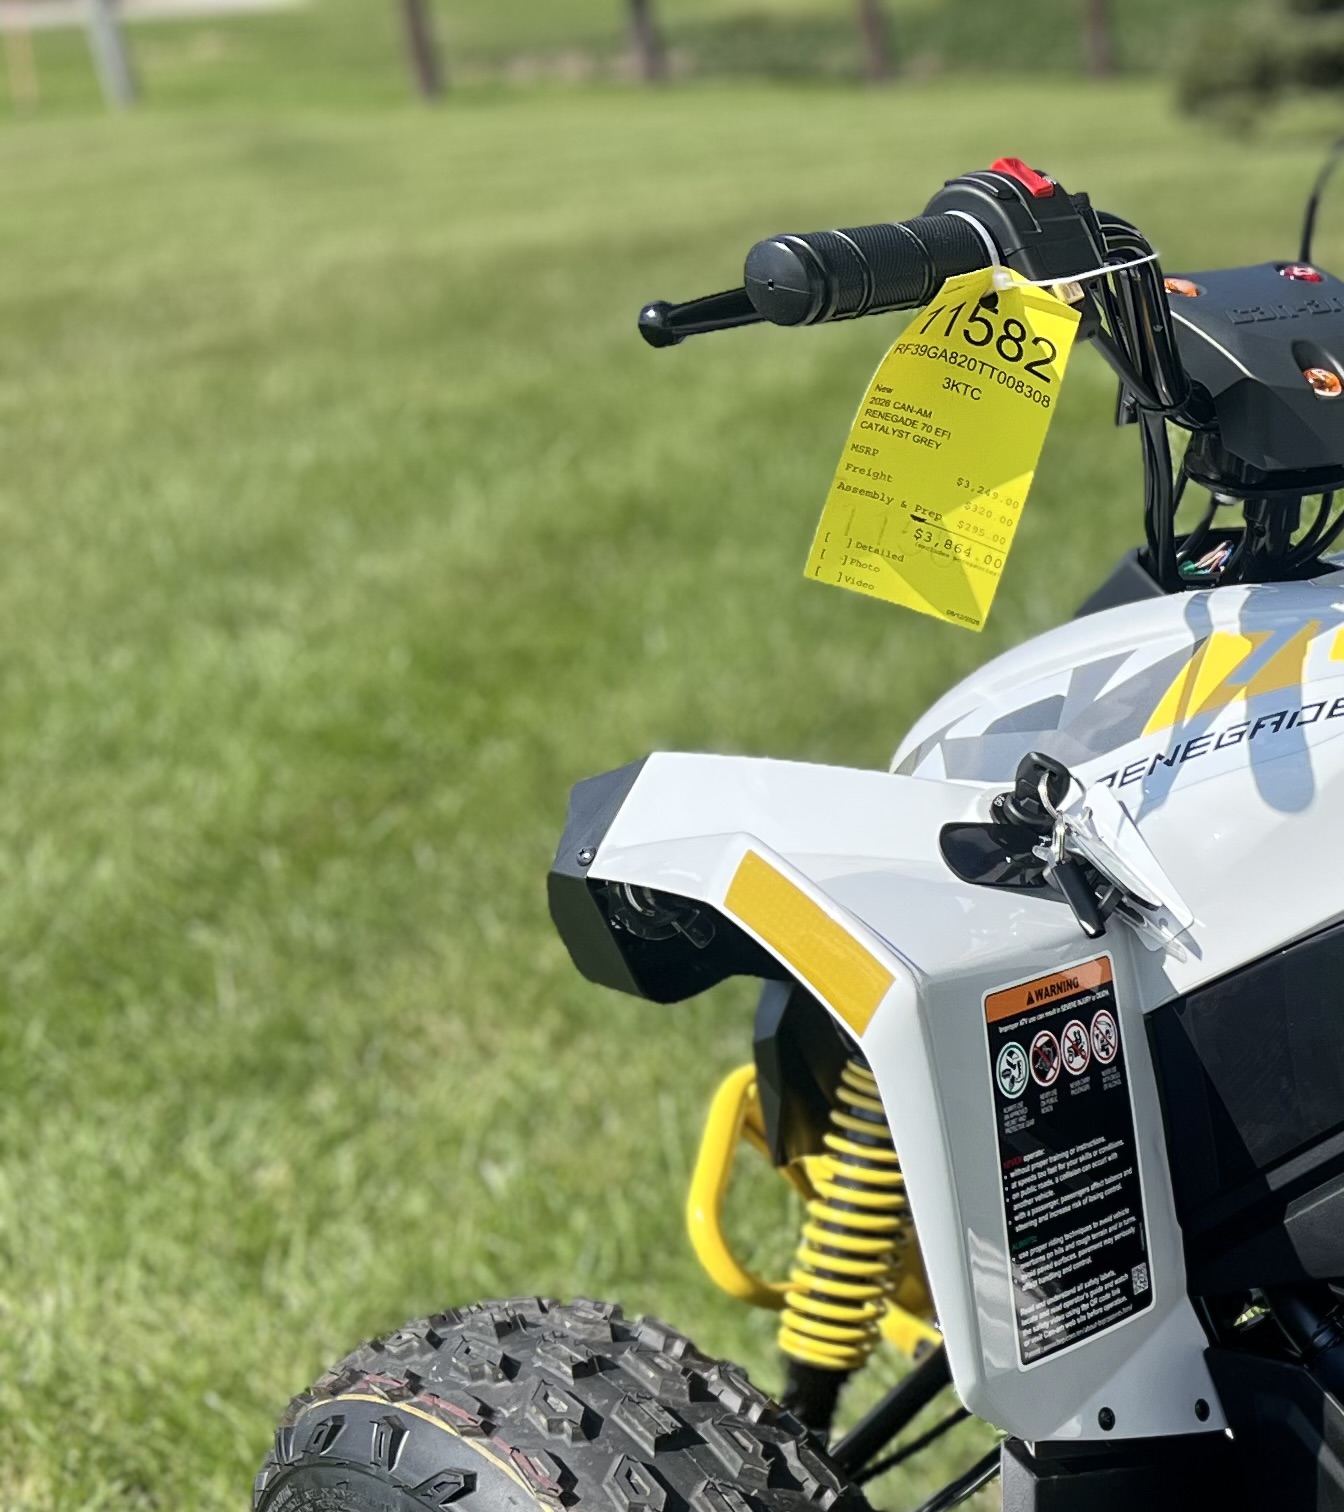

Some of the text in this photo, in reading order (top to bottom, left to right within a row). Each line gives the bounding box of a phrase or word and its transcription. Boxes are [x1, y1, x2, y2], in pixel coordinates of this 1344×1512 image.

[920, 301, 1057, 383] 11582
[875, 384, 894, 394] New
[893, 343, 1051, 409] RF39GA820TT008308
[942, 377, 982, 401] 3KTC
[864, 408, 952, 440] RENEGADE 70 EFI
[893, 401, 933, 419] CAN-AM
[850, 443, 879, 457] MSRP
[860, 420, 942, 450] CATALYST GREY
[845, 463, 1013, 528] Freight $320.00
[956, 477, 1019, 510] $3,249.00
[837, 481, 1007, 545] Assembly & Prep $295.00
[914, 528, 1003, 569] $3,864.00
[1034, 976, 1079, 1002] WARNING
[1009, 1164, 1030, 1179] without
[1048, 1148, 1069, 1164] training
